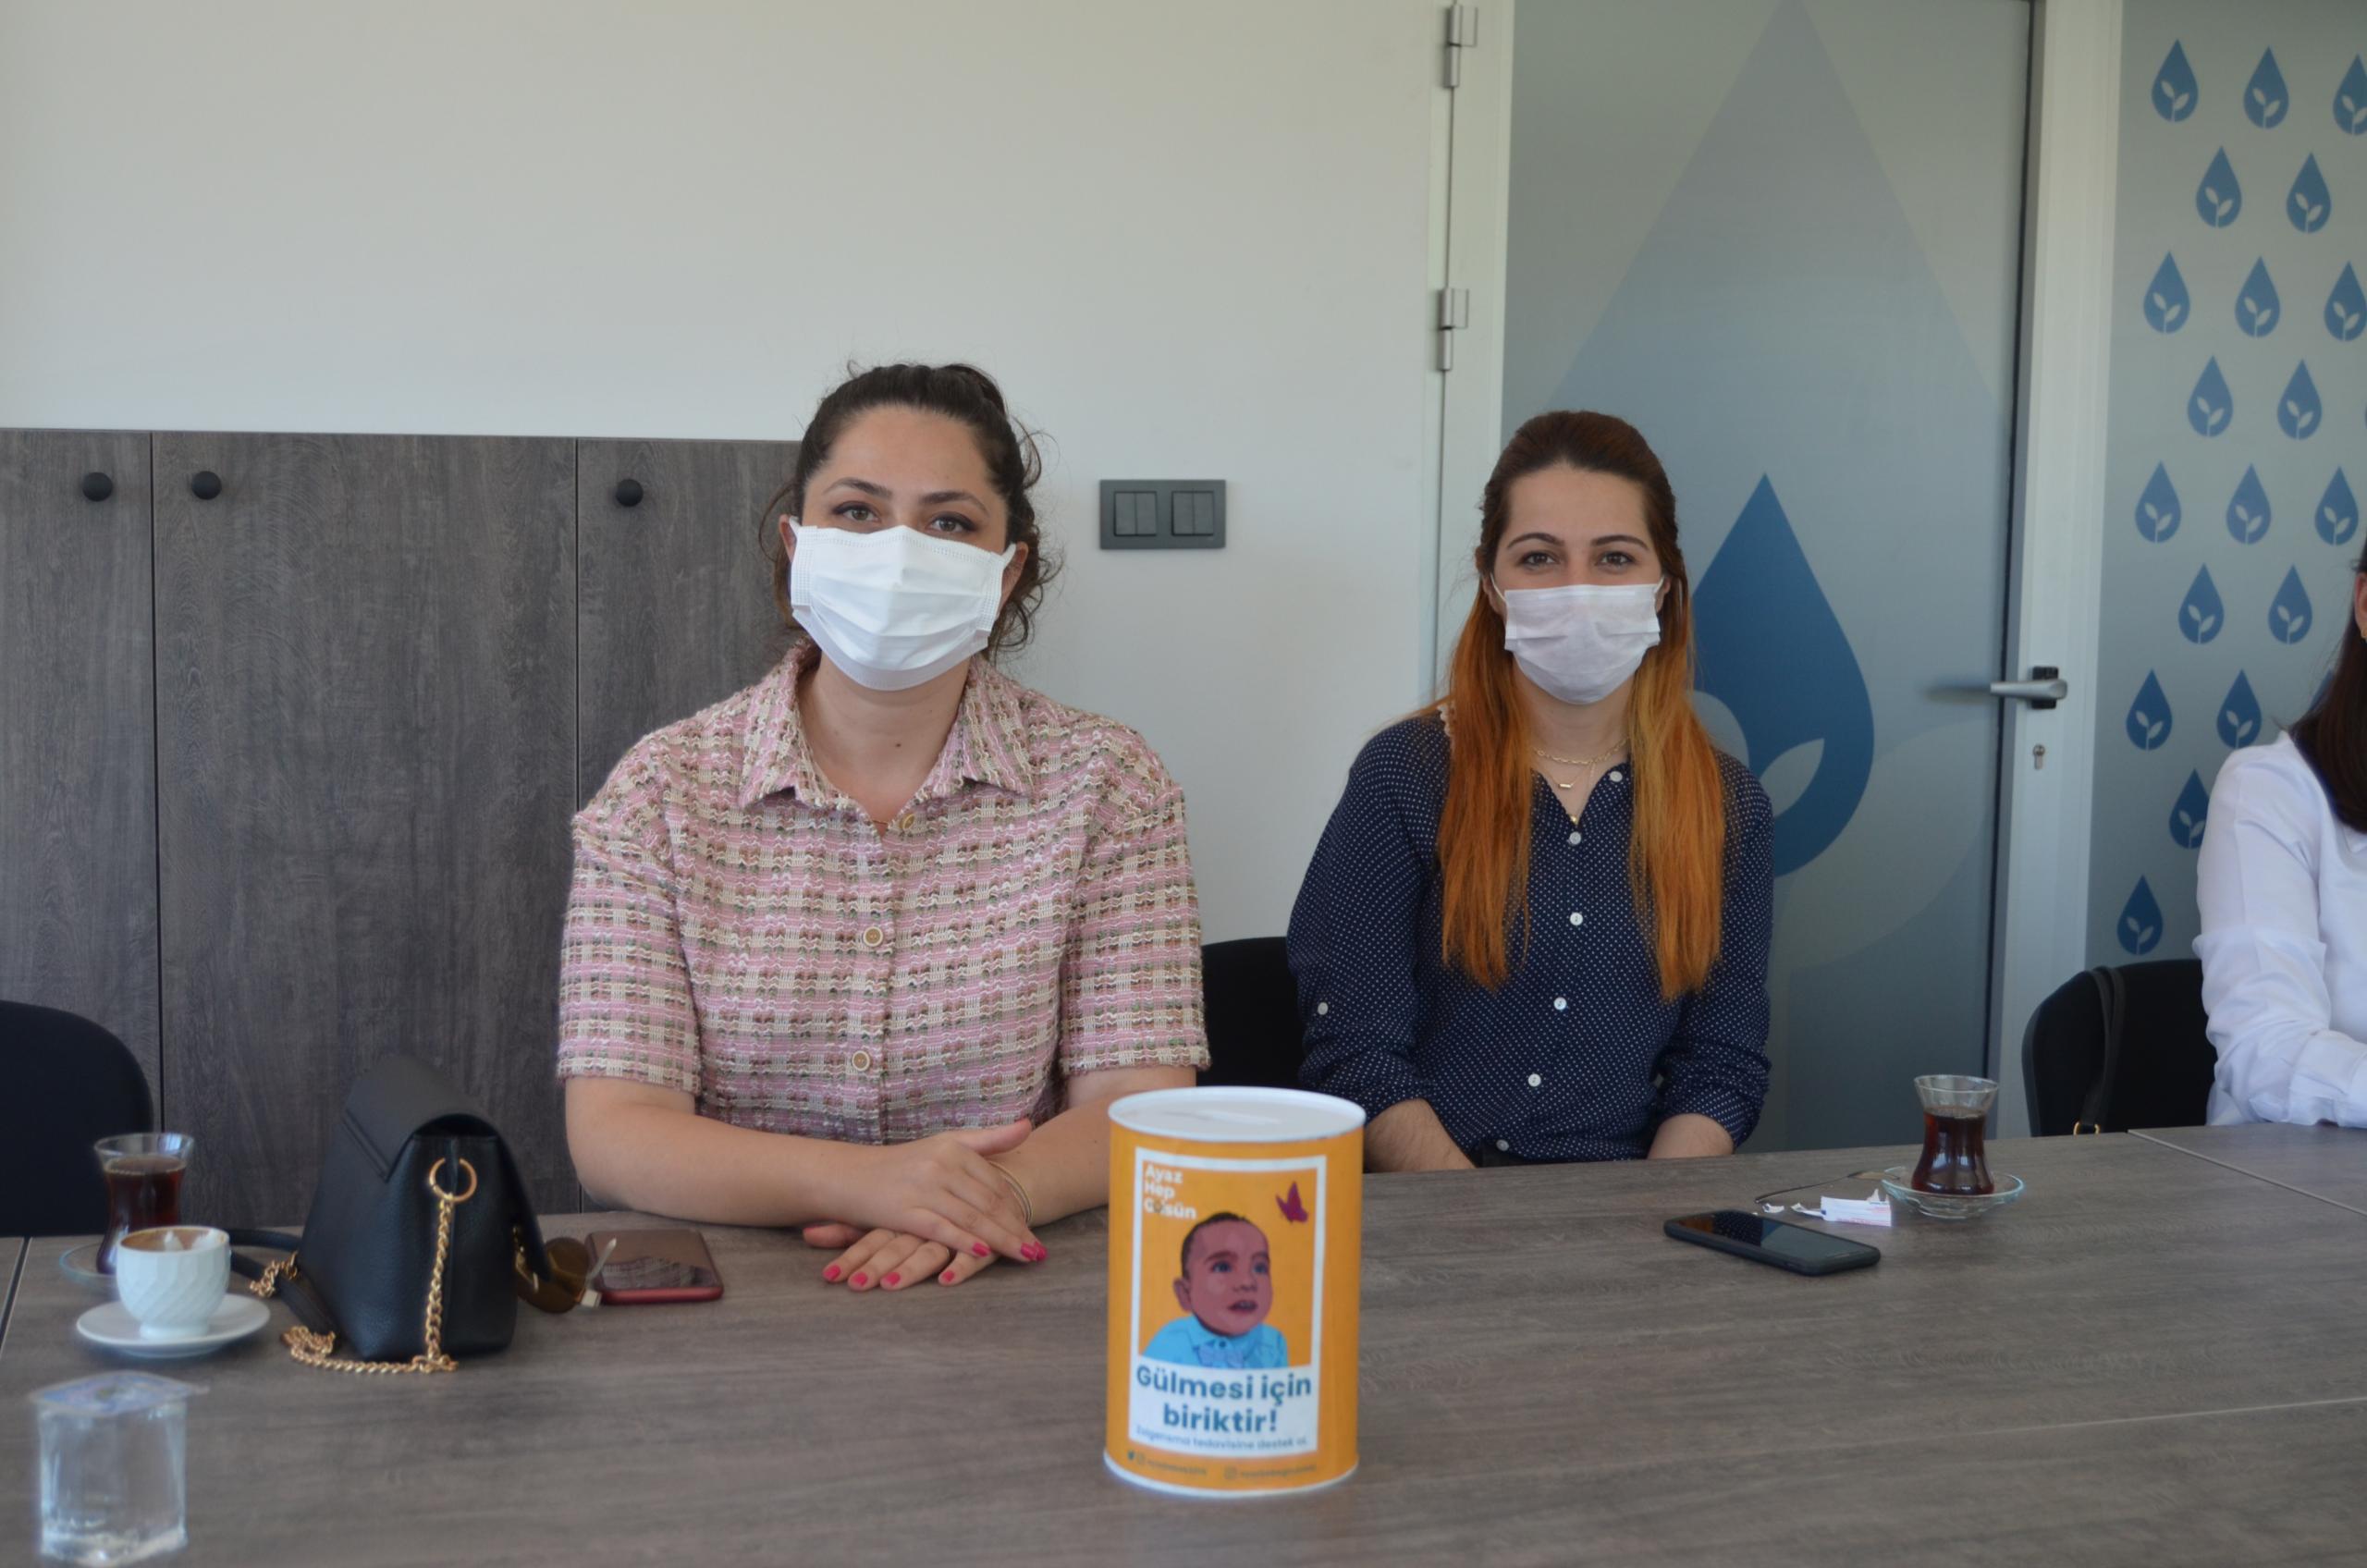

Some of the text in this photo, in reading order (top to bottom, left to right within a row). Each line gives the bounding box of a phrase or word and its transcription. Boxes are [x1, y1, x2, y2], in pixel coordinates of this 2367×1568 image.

[1146, 1164, 1184, 1185] Ayaz
[1145, 1182, 1175, 1199] Hep
[1136, 1365, 1311, 1406] Gülmesi için
[1163, 1403, 1278, 1433] biriktir!
